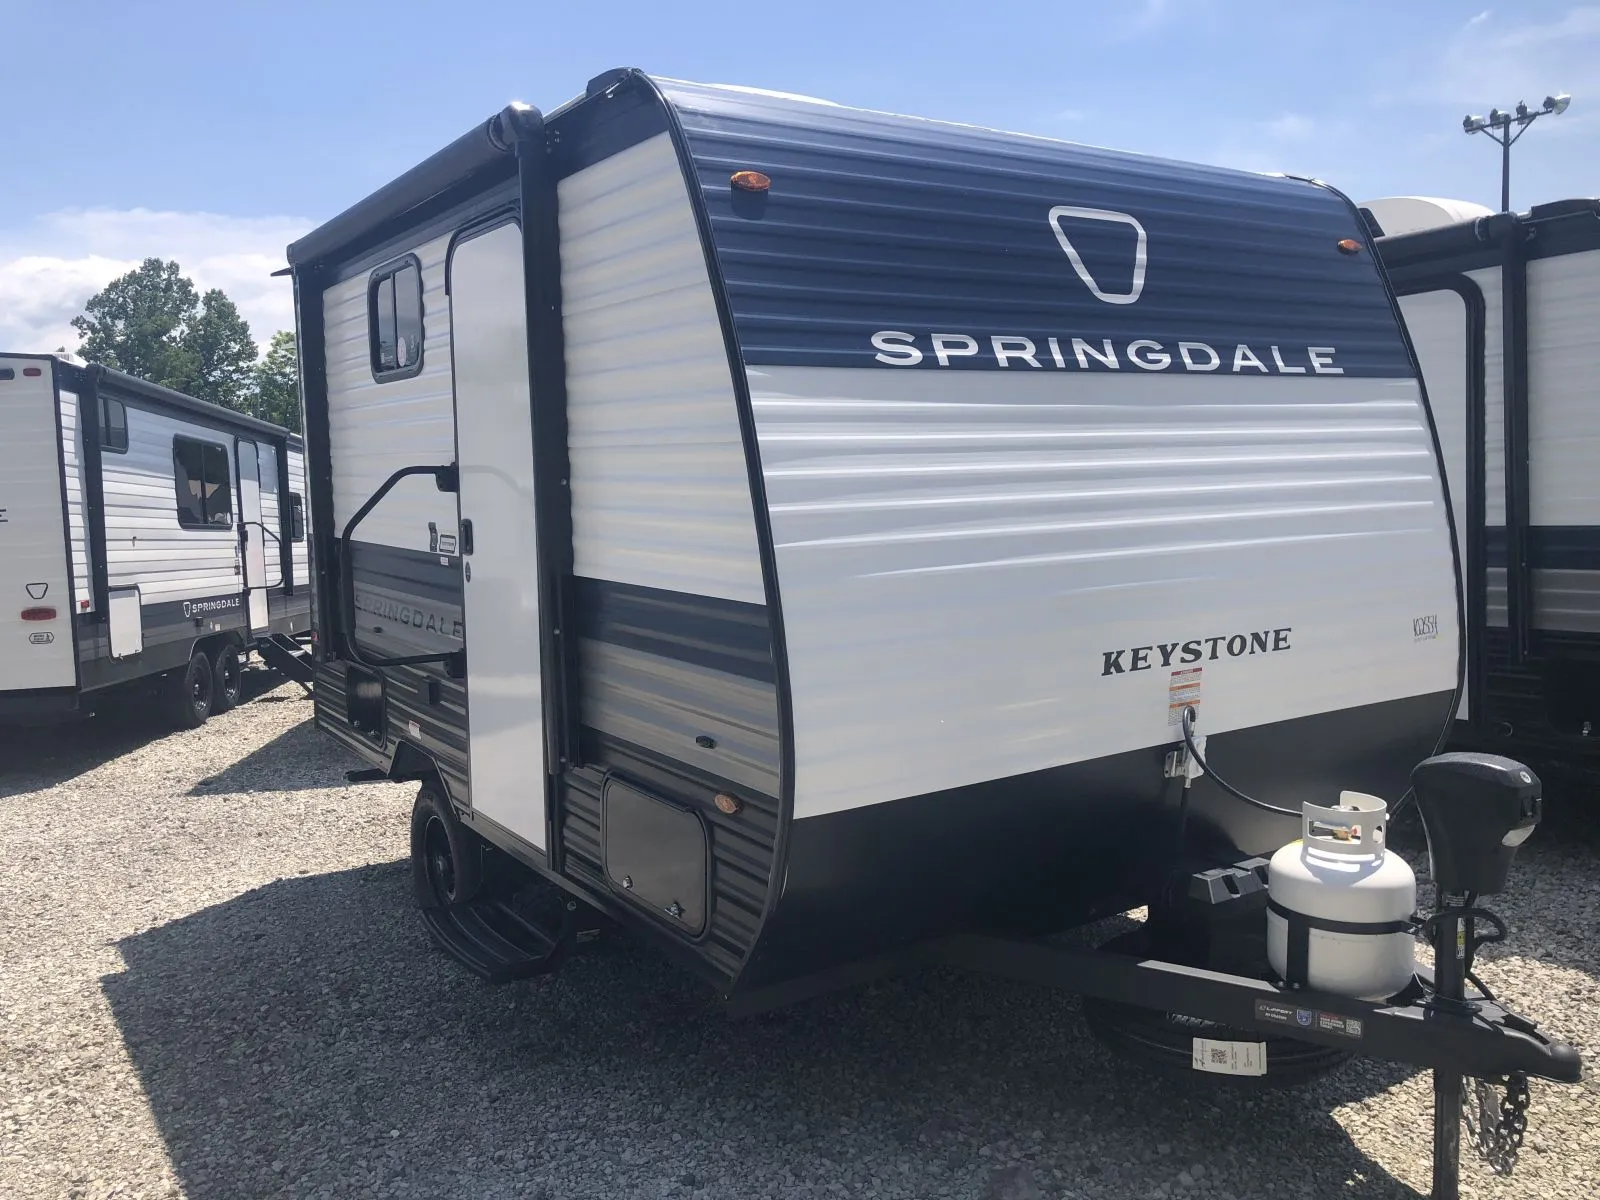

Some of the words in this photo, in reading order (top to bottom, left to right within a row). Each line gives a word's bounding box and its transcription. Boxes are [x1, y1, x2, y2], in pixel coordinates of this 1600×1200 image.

[870, 330, 1345, 375] SPRINGDALE
[192, 598, 241, 613] SPRINGDALE
[1101, 628, 1292, 676] KEYSTONE
